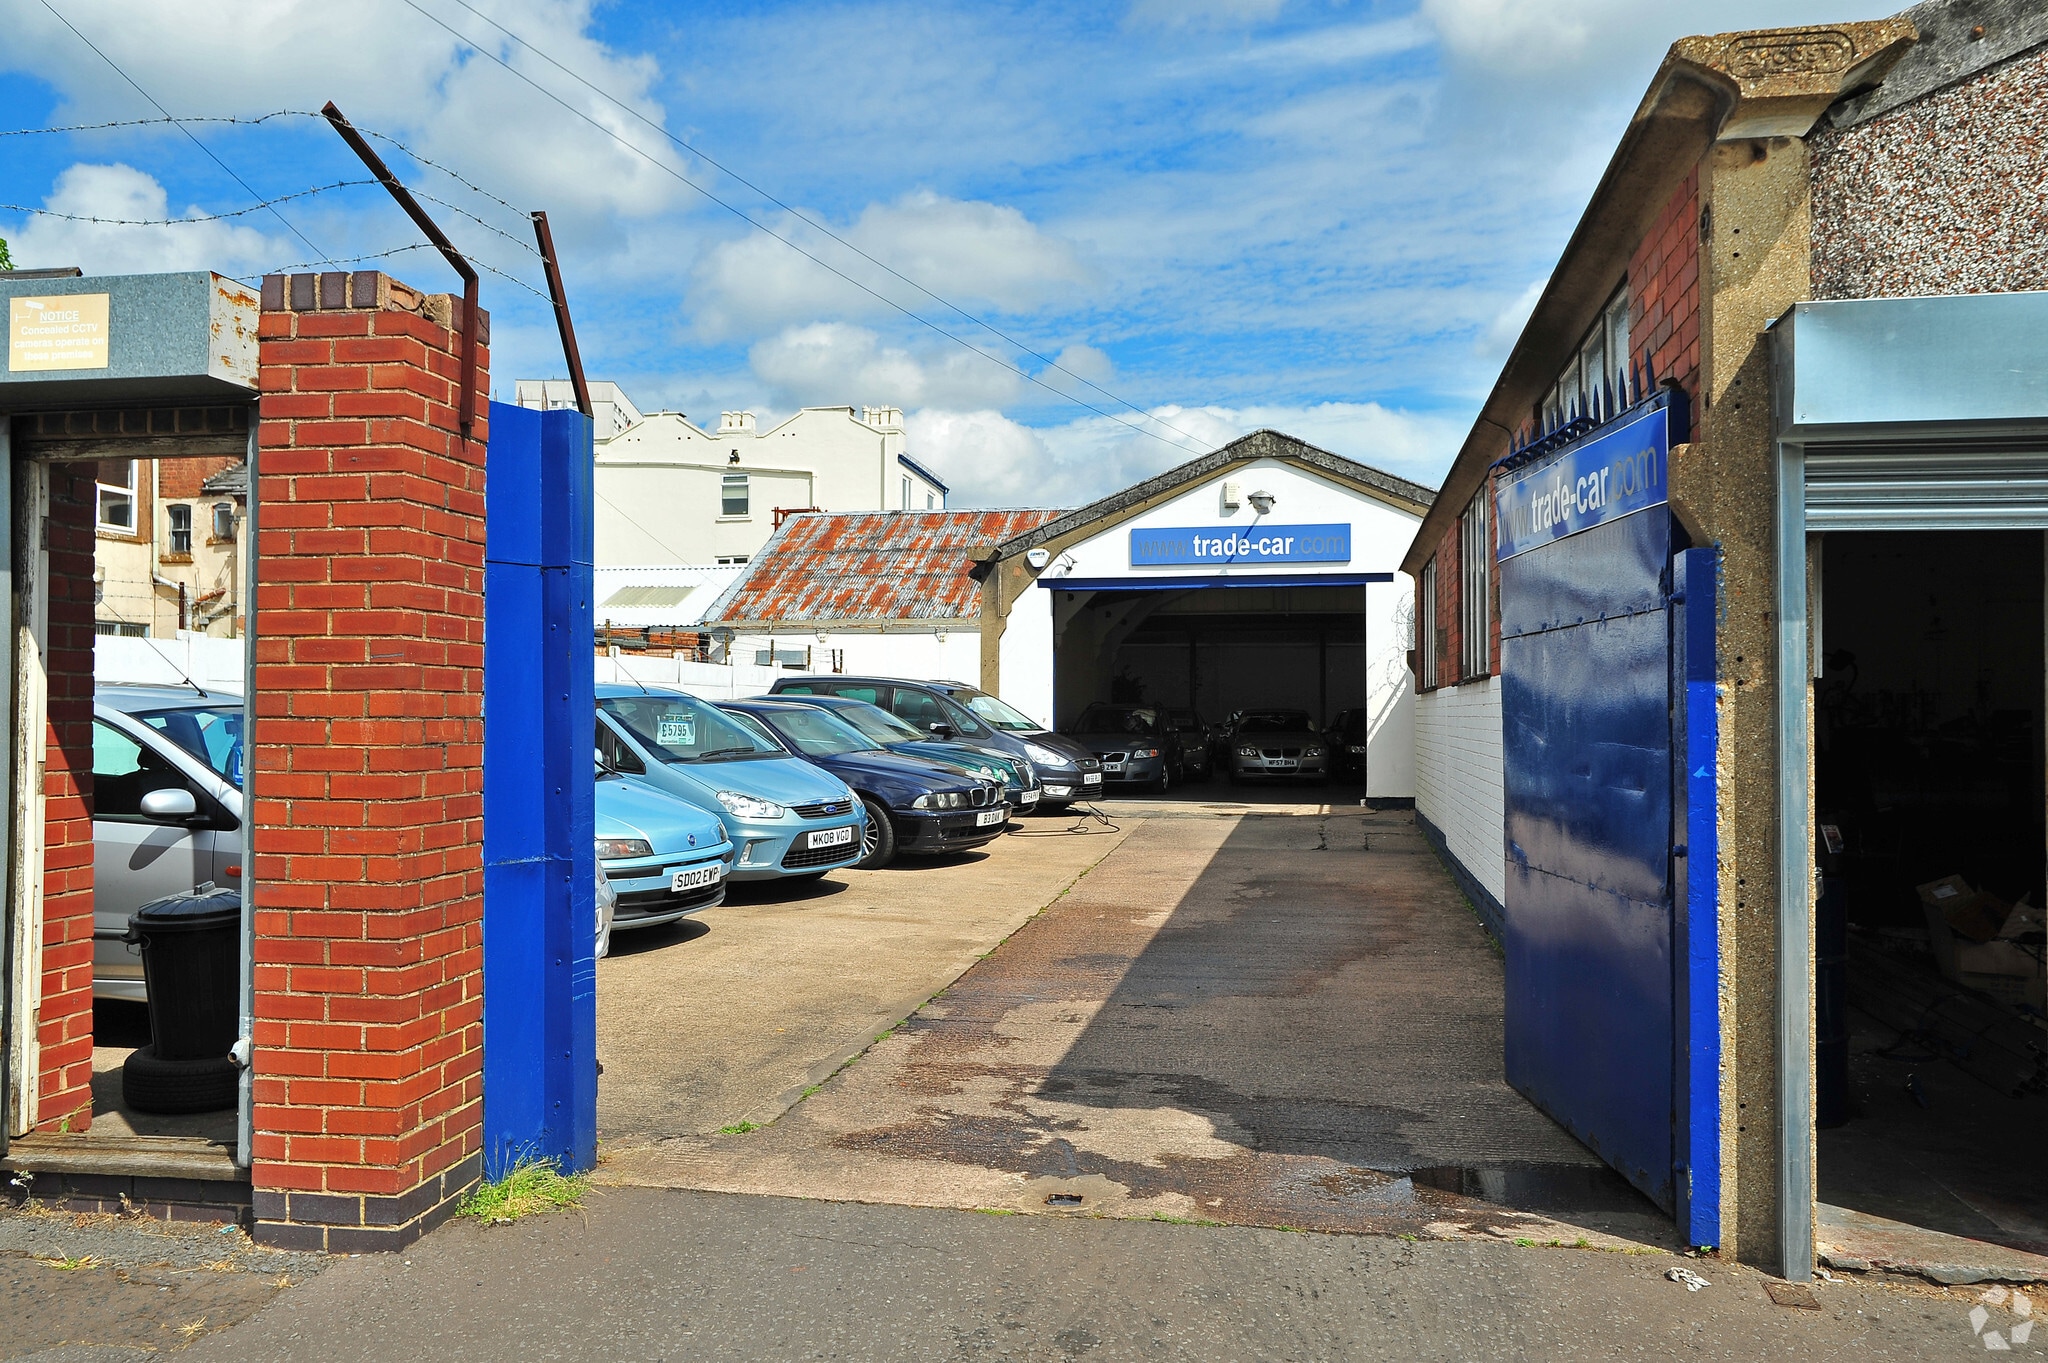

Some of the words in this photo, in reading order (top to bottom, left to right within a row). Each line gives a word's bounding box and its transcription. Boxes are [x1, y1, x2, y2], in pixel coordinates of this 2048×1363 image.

[40, 311, 79, 321] NOTICE
[21, 326, 69, 335] Concealed
[72, 324, 97, 333] CCTV
[14, 340, 53, 348] cameras
[55, 338, 89, 348] operate
[1499, 446, 1657, 546] www.trade-car.com
[1138, 533, 1345, 557] www.trade-car.com
[661, 723, 687, 737] £5795
[812, 832, 834, 846] MK08
[836, 829, 849, 842] VGD
[676, 871, 701, 888] SD02
[703, 866, 719, 882] EWP
